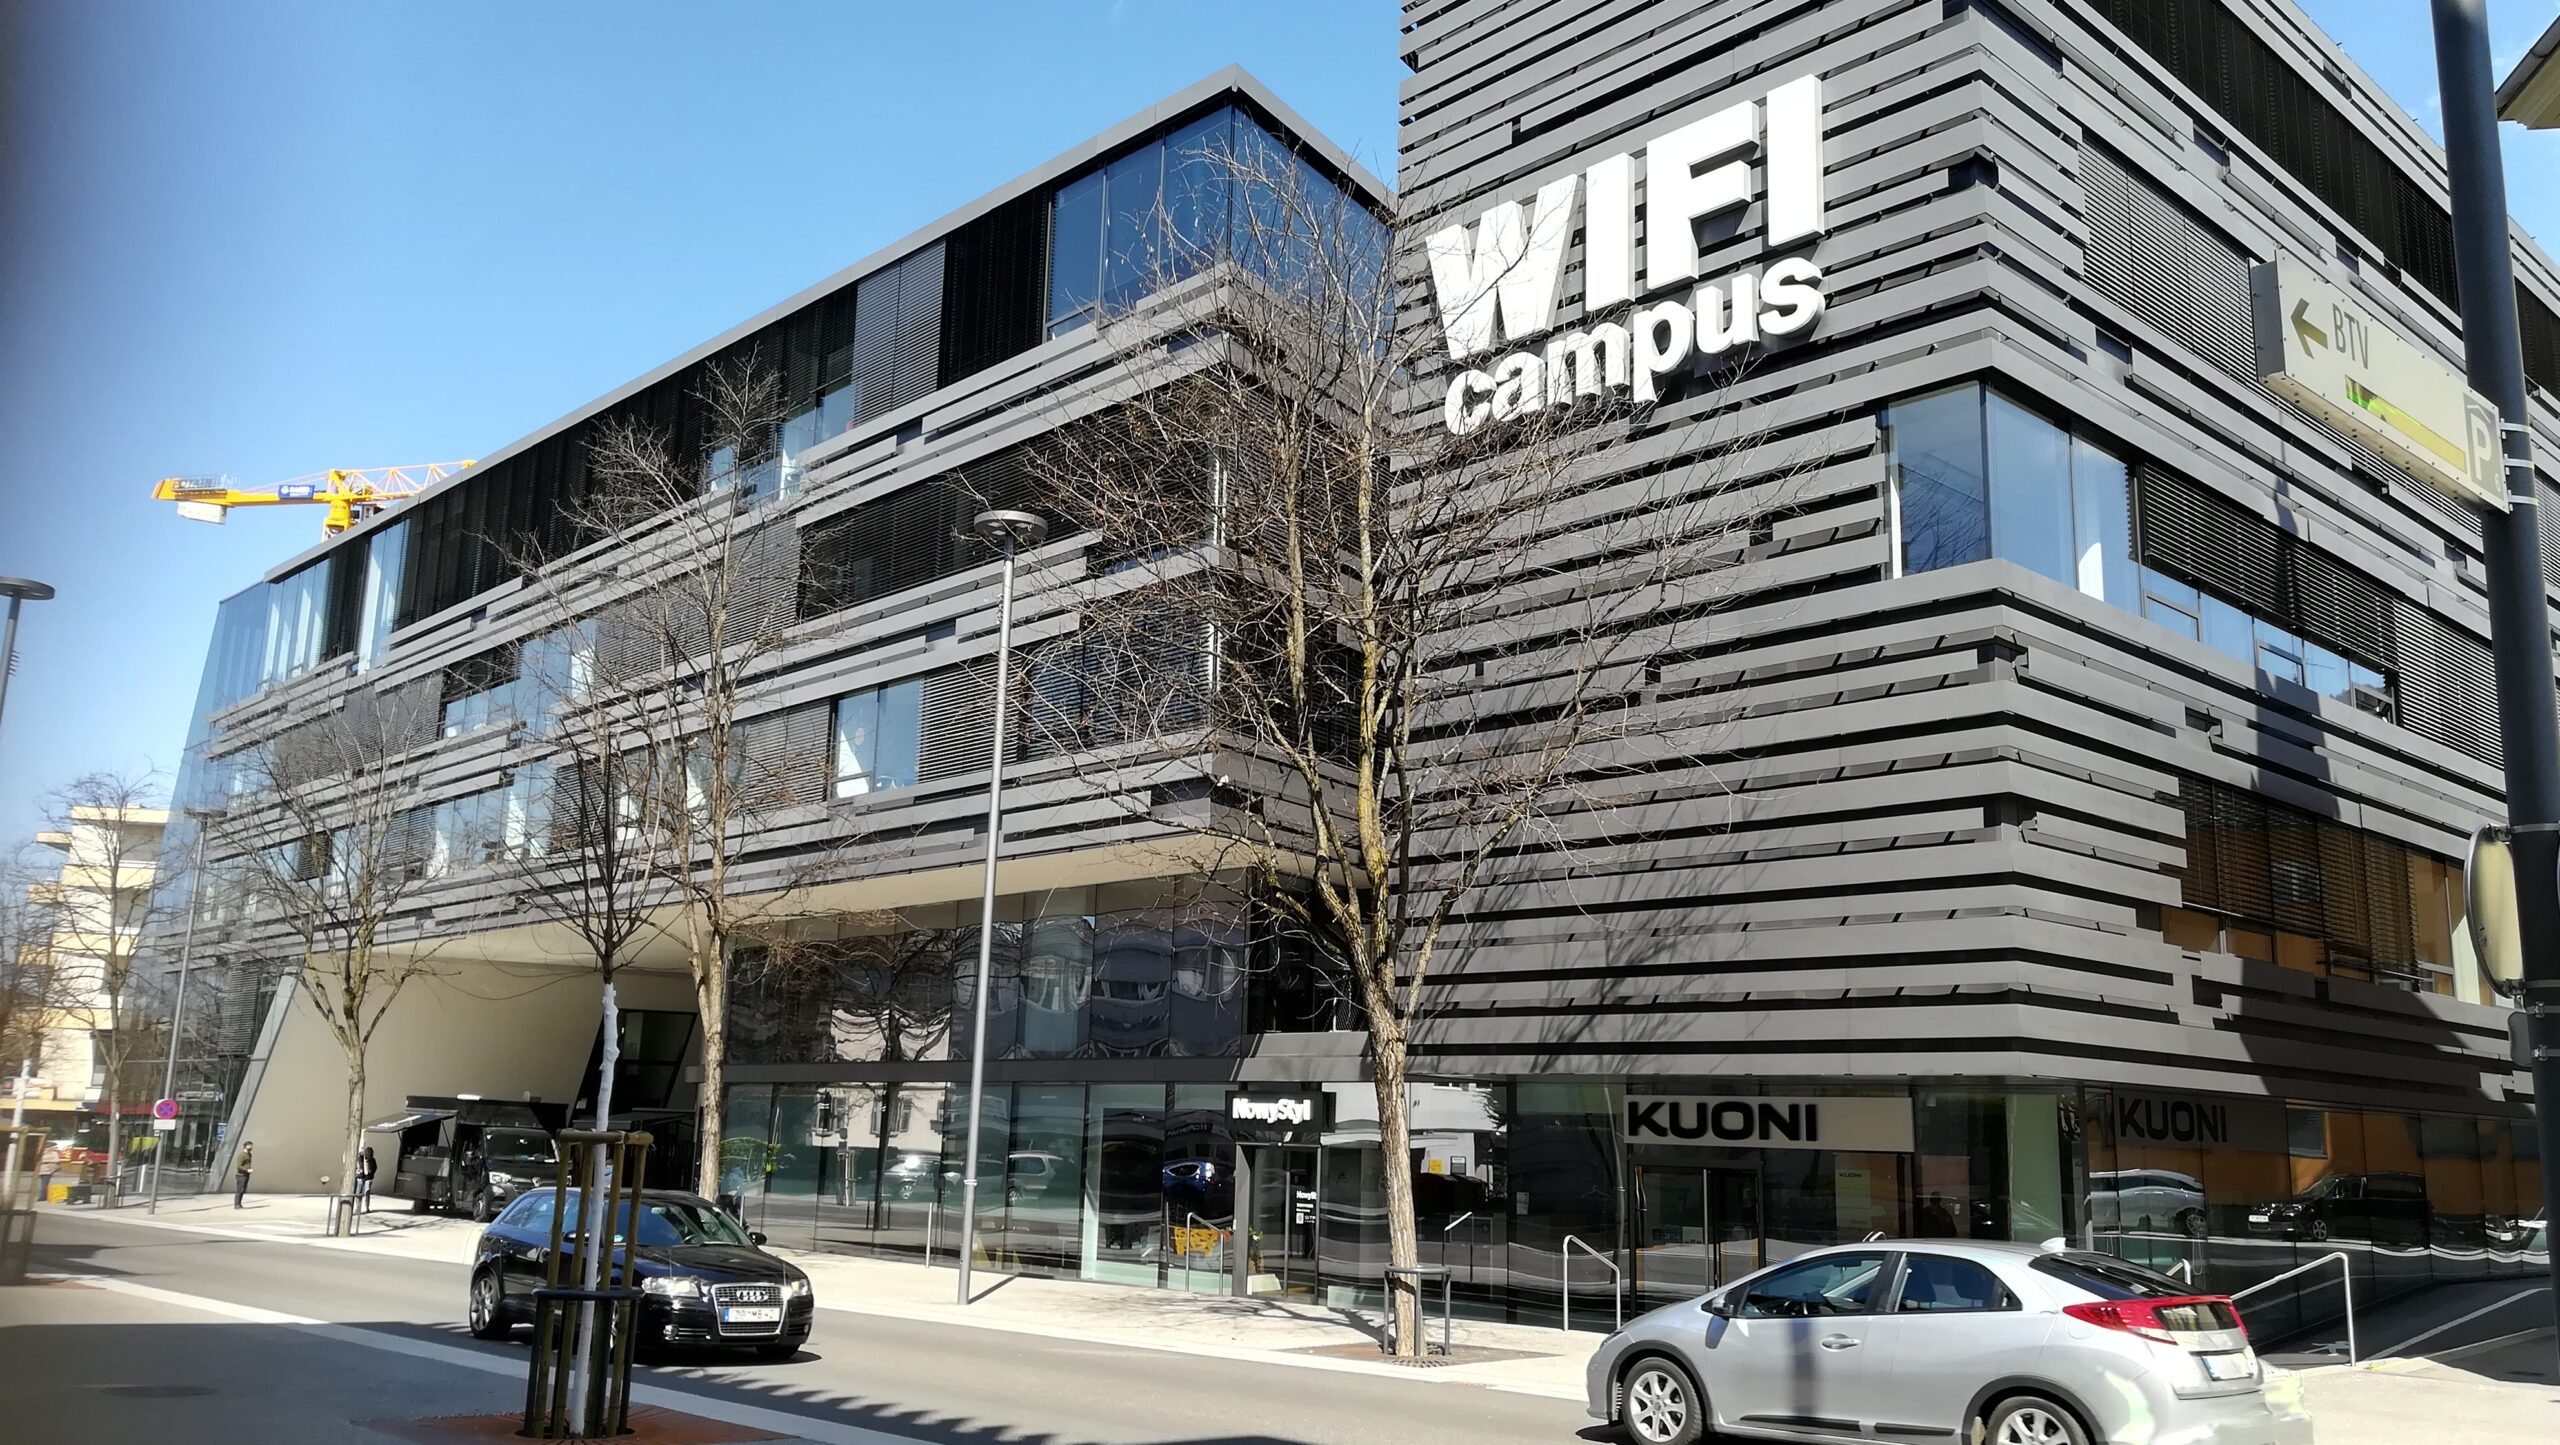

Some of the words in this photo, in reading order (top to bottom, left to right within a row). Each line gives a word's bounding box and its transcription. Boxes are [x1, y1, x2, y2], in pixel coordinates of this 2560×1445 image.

[1425, 74, 1824, 360] WIFI
[1445, 257, 1825, 435] campus
[2332, 303, 2368, 370] BTV
[2470, 413, 2492, 480] P
[1232, 1098, 1311, 1124] NowyStyl
[1628, 1101, 1818, 1142] KUONI
[2118, 1097, 2228, 1143] KUONI
